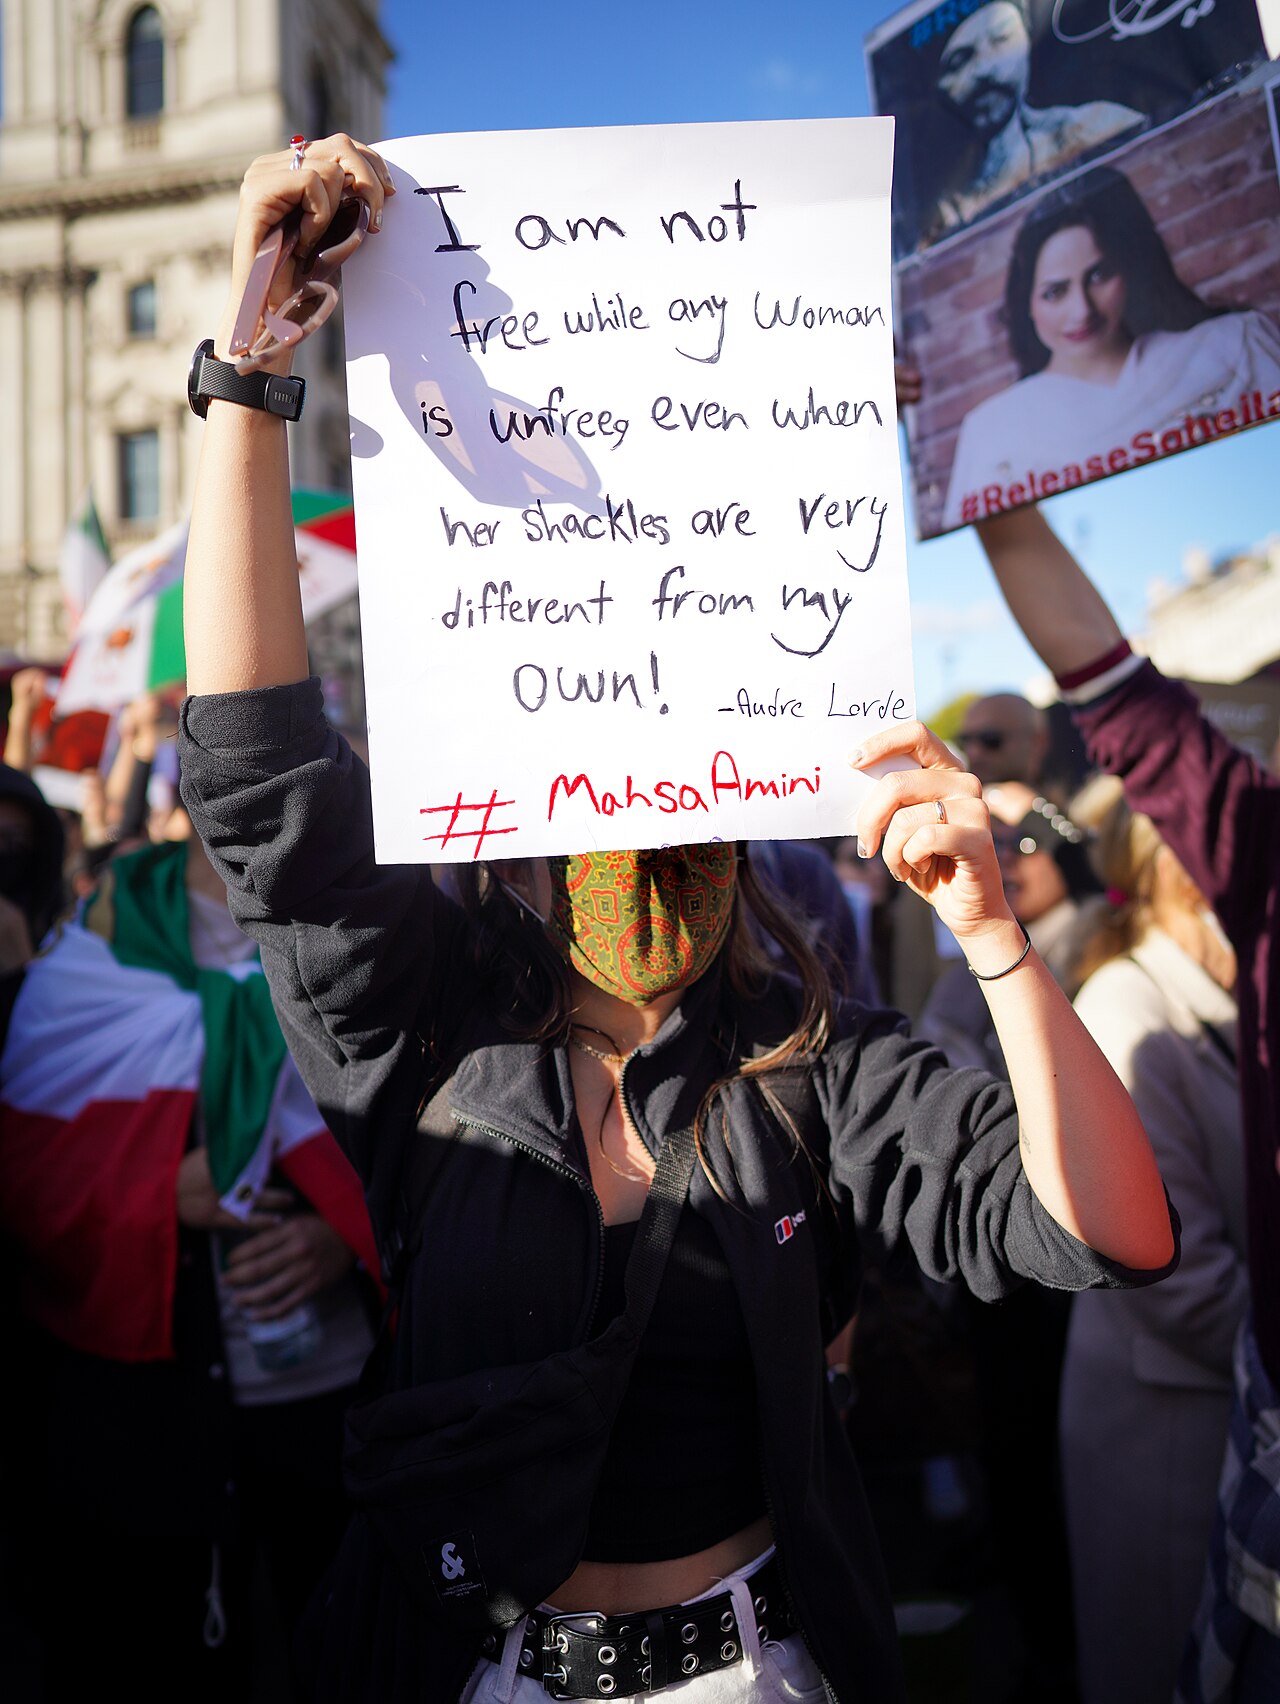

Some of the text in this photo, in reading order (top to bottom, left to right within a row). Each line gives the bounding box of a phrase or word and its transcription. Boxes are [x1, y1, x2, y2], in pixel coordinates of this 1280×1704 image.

[414, 179, 757, 252] I am not
[450, 280, 886, 364] free while any Woman
[420, 402, 454, 438] is
[650, 395, 750, 431] even
[771, 386, 883, 431] when
[440, 507, 501, 547] her
[691, 502, 757, 538] are
[441, 566, 853, 659] different from my
[827, 682, 912, 720] Lorde
